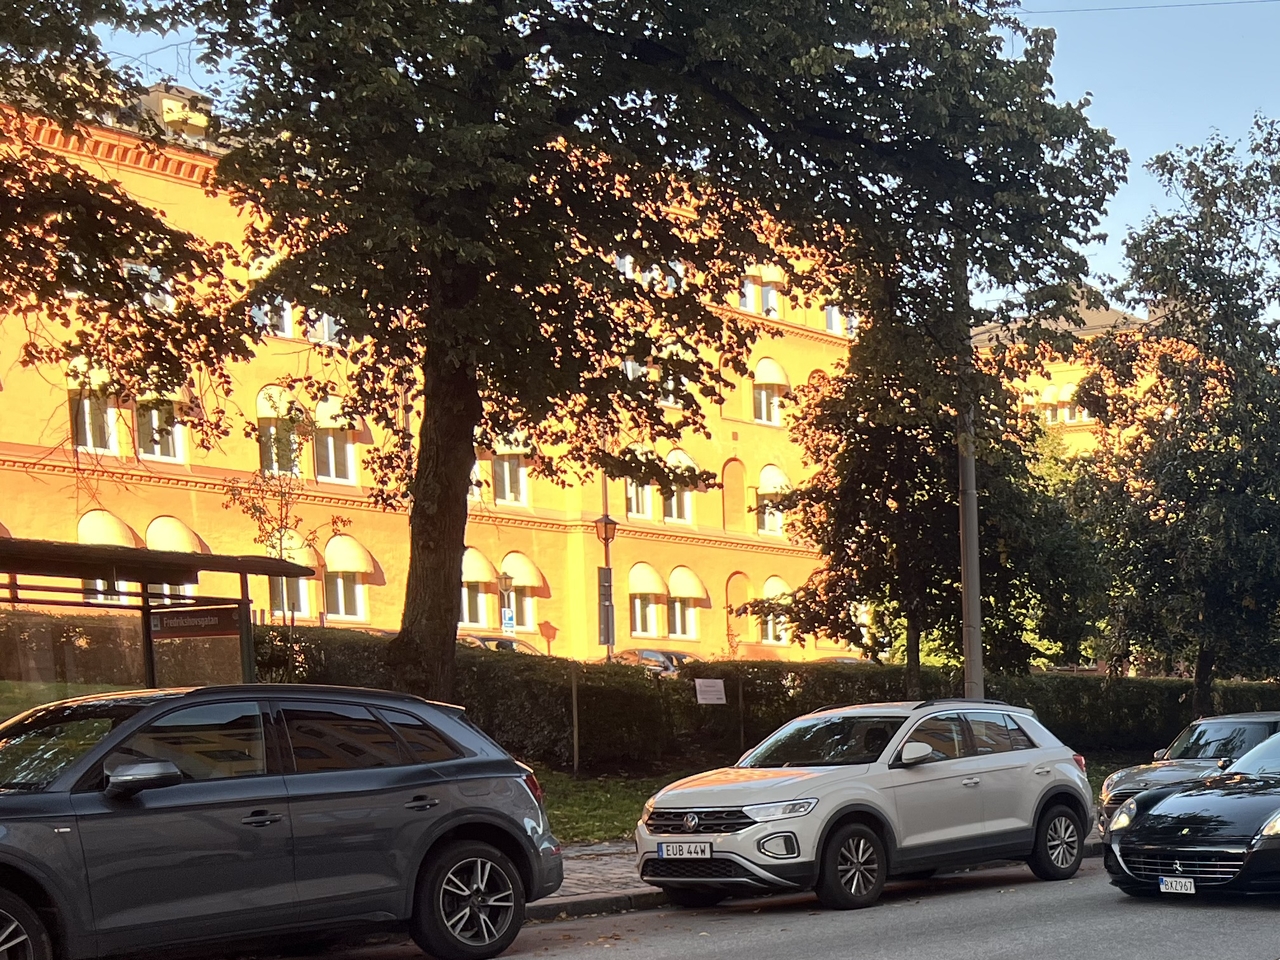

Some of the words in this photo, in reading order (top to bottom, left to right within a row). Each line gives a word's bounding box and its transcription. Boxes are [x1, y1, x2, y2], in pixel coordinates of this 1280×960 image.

[163, 616, 219, 628] Fredrikshovsgatan
[666, 844, 684, 857] EUB
[687, 844, 706, 857] 44W
[1164, 879, 1193, 892] BXZ967
